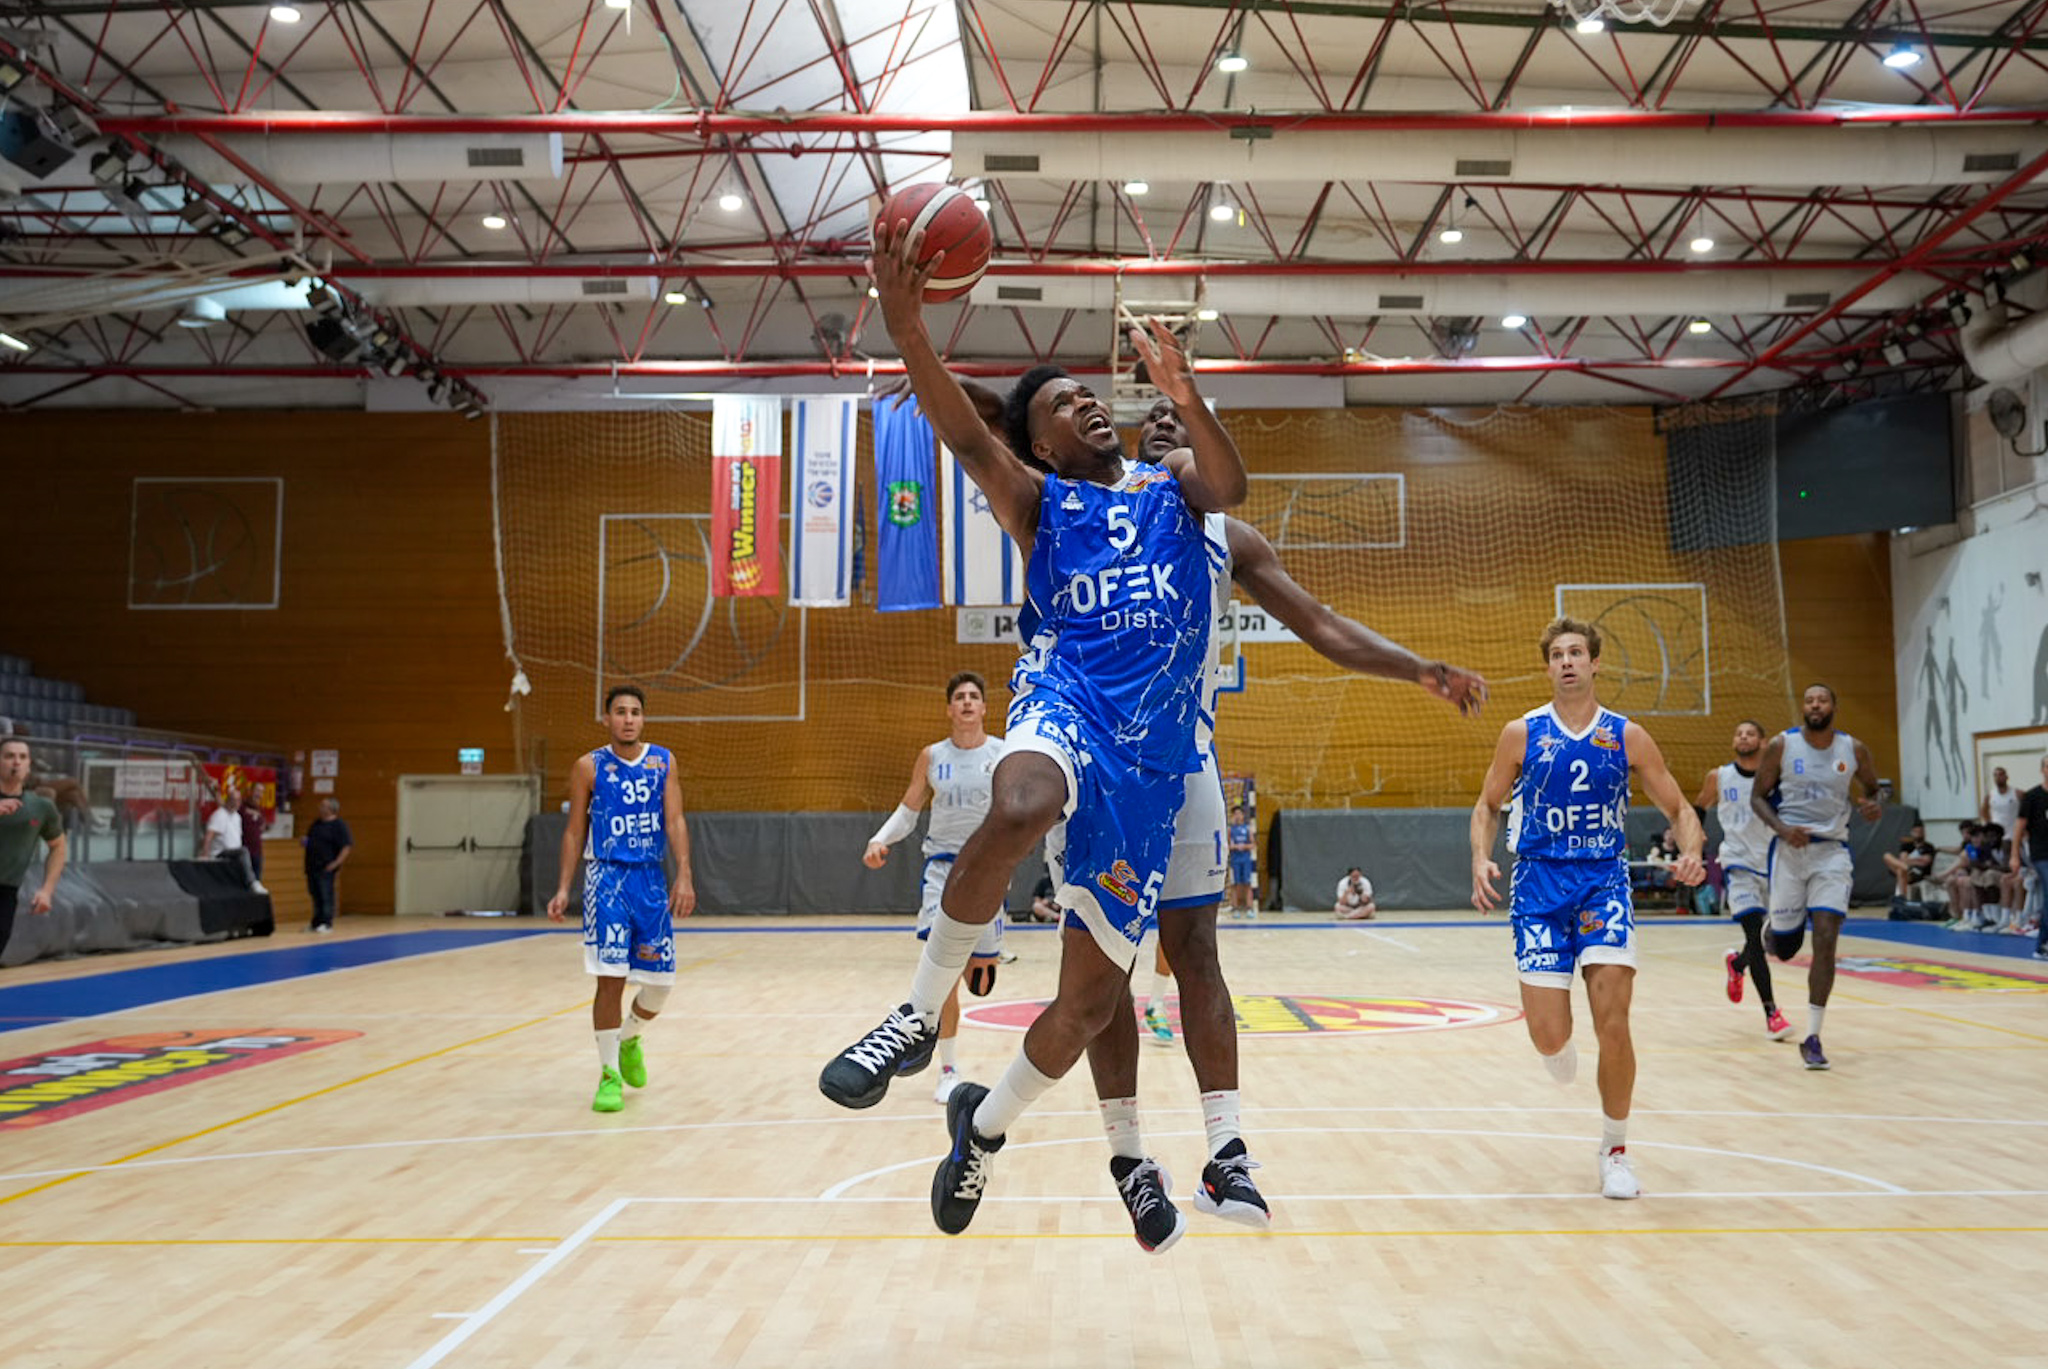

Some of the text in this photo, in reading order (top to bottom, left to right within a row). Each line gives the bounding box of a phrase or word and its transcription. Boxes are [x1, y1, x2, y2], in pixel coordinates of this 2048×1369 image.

[731, 460, 756, 560] Winner
[1107, 505, 1138, 550] 5
[1070, 563, 1179, 614] OFEK
[1101, 608, 1165, 631] Dist.
[938, 763, 951, 780] 11
[1570, 759, 1591, 792] 2
[1794, 758, 1805, 774] 6
[620, 779, 651, 805] 35
[1723, 788, 1738, 802] 10
[611, 812, 661, 837] OFEK
[1546, 803, 1619, 833] OFEK
[1137, 869, 1164, 917] 5
[1606, 900, 1626, 932] 2
[661, 936, 675, 962] 3
